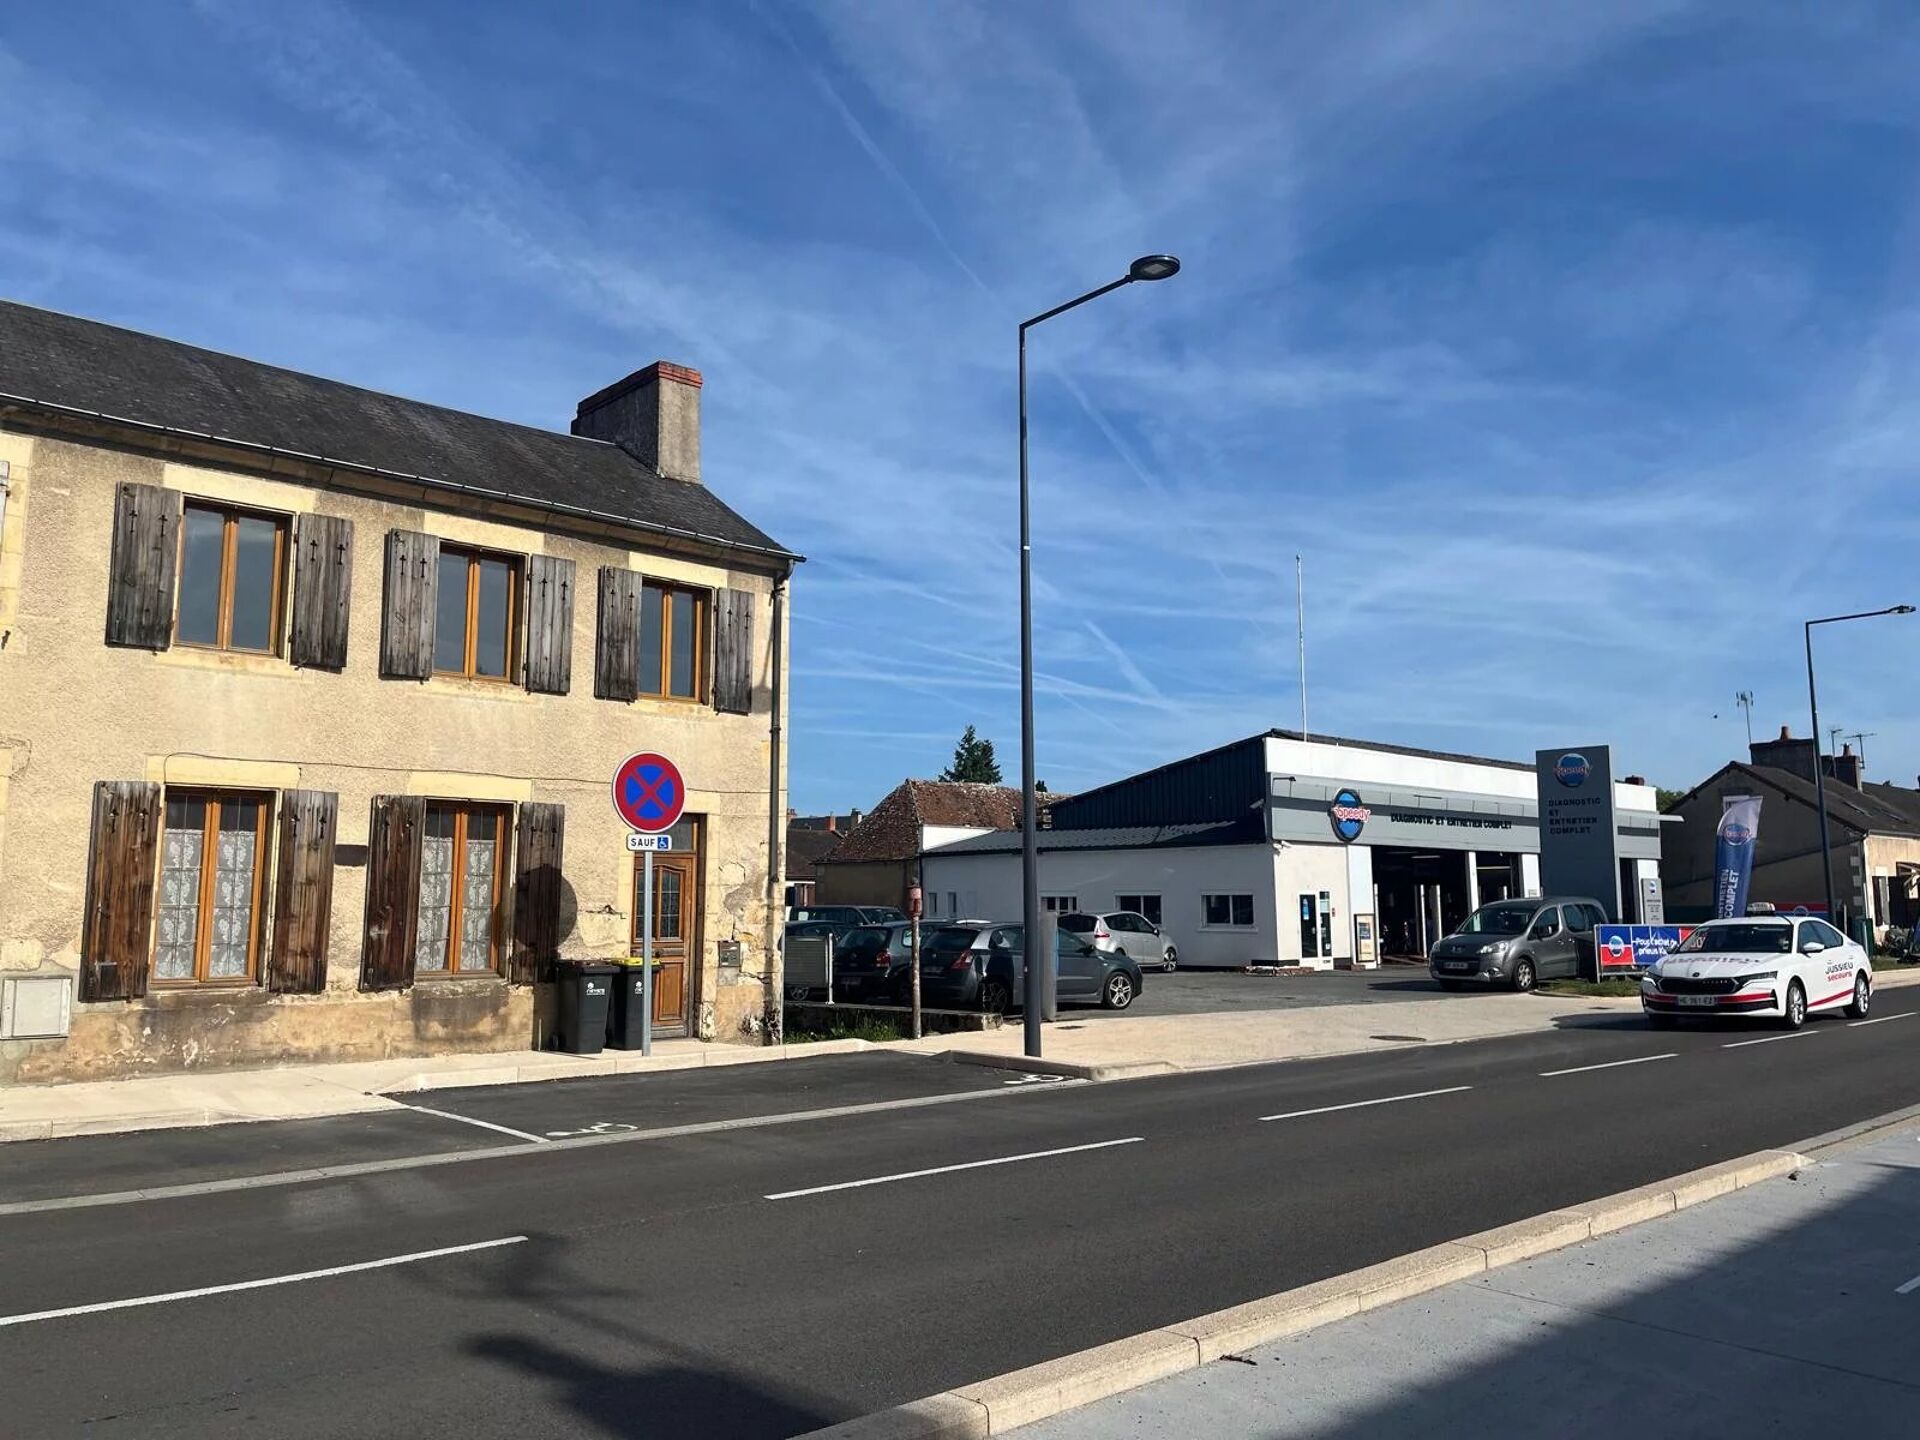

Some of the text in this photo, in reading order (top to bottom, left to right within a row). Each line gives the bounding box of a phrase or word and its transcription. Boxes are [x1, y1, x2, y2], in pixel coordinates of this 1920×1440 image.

[1548, 798, 1601, 807] DIAGNOSTIC
[1333, 805, 1371, 822] Speedy
[1391, 812, 1433, 825] DIAGNOSTIC
[1549, 817, 1597, 825] ENTRETIEN
[1550, 826, 1591, 834] COMPLET
[630, 838, 655, 847] SAUF
[1724, 869, 1740, 919] COMPLET
[1825, 961, 1854, 975] JUSSIEU
